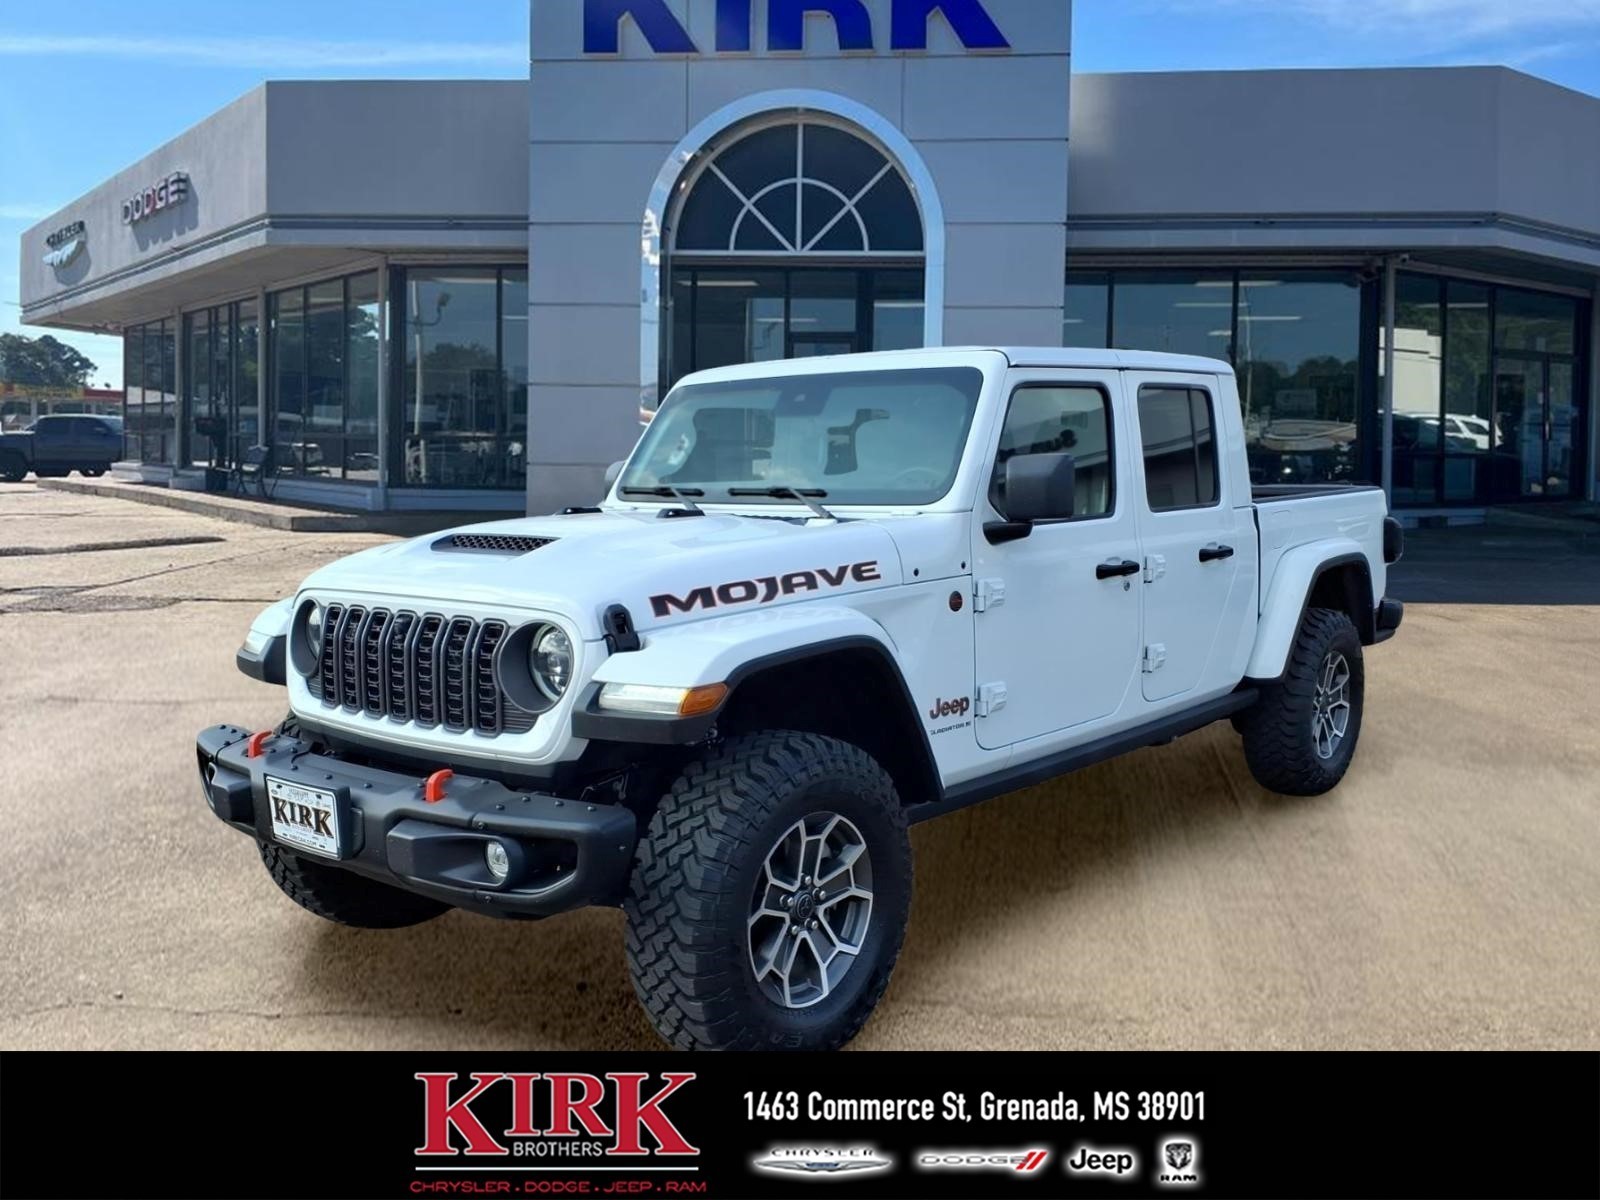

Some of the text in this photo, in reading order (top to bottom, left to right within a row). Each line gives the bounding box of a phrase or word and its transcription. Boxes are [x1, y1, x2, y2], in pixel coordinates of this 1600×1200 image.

[121, 171, 189, 226] DODGE
[649, 560, 881, 617] MOJAVE
[929, 696, 970, 720] Jeep
[271, 796, 334, 839] KIRK
